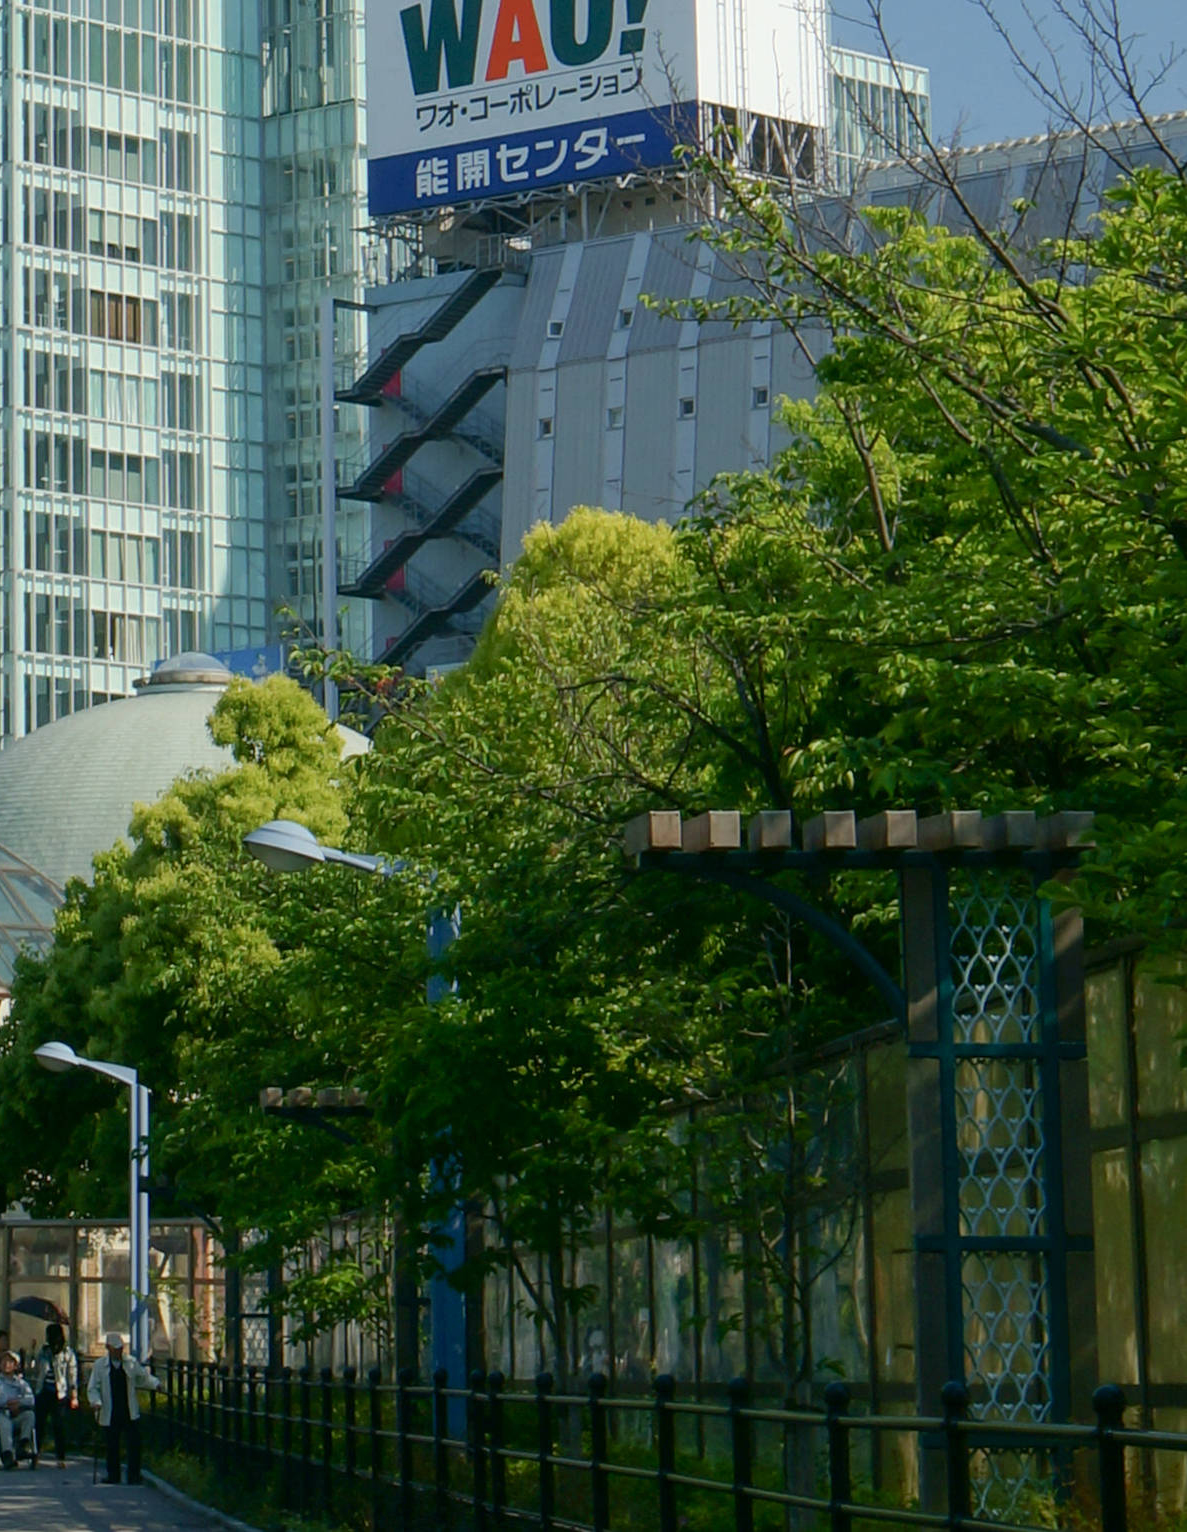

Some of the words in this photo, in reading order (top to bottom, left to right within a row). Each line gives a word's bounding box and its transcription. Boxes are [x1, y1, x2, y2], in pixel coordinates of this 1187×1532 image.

[416, 66, 643, 132] ワオ・コーポレーション
[415, 127, 646, 198] 能開センター
